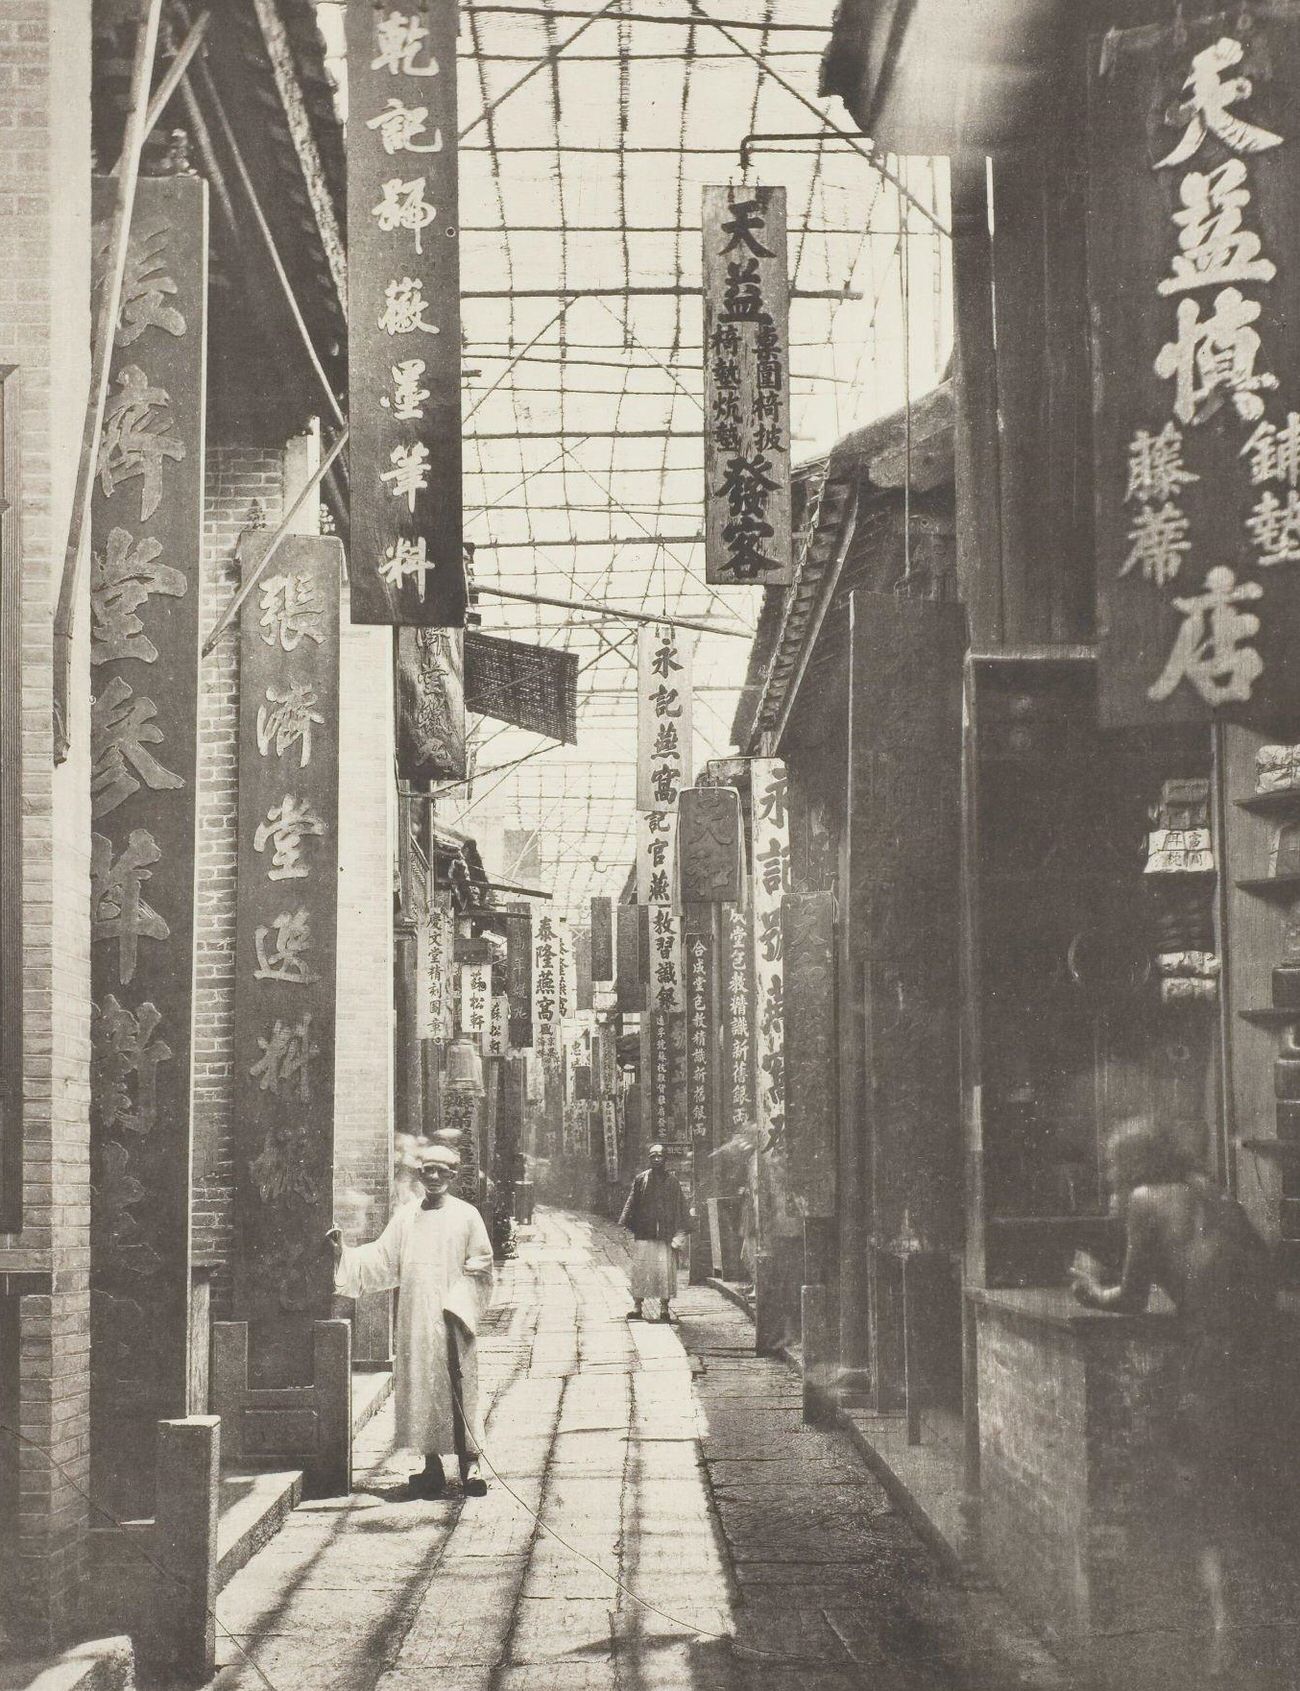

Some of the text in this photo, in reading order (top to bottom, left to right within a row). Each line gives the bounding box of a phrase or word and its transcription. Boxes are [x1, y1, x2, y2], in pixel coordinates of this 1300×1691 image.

[718, 199, 777, 325] 天益
[1154, 36, 1284, 425] 天益慎
[716, 454, 783, 578] 發客
[1147, 565, 1266, 707] 店
[649, 637, 684, 805] 永記燕窩
[535, 916, 558, 1022] 泰隆燕窩
[653, 904, 679, 1010] 教習識銀
